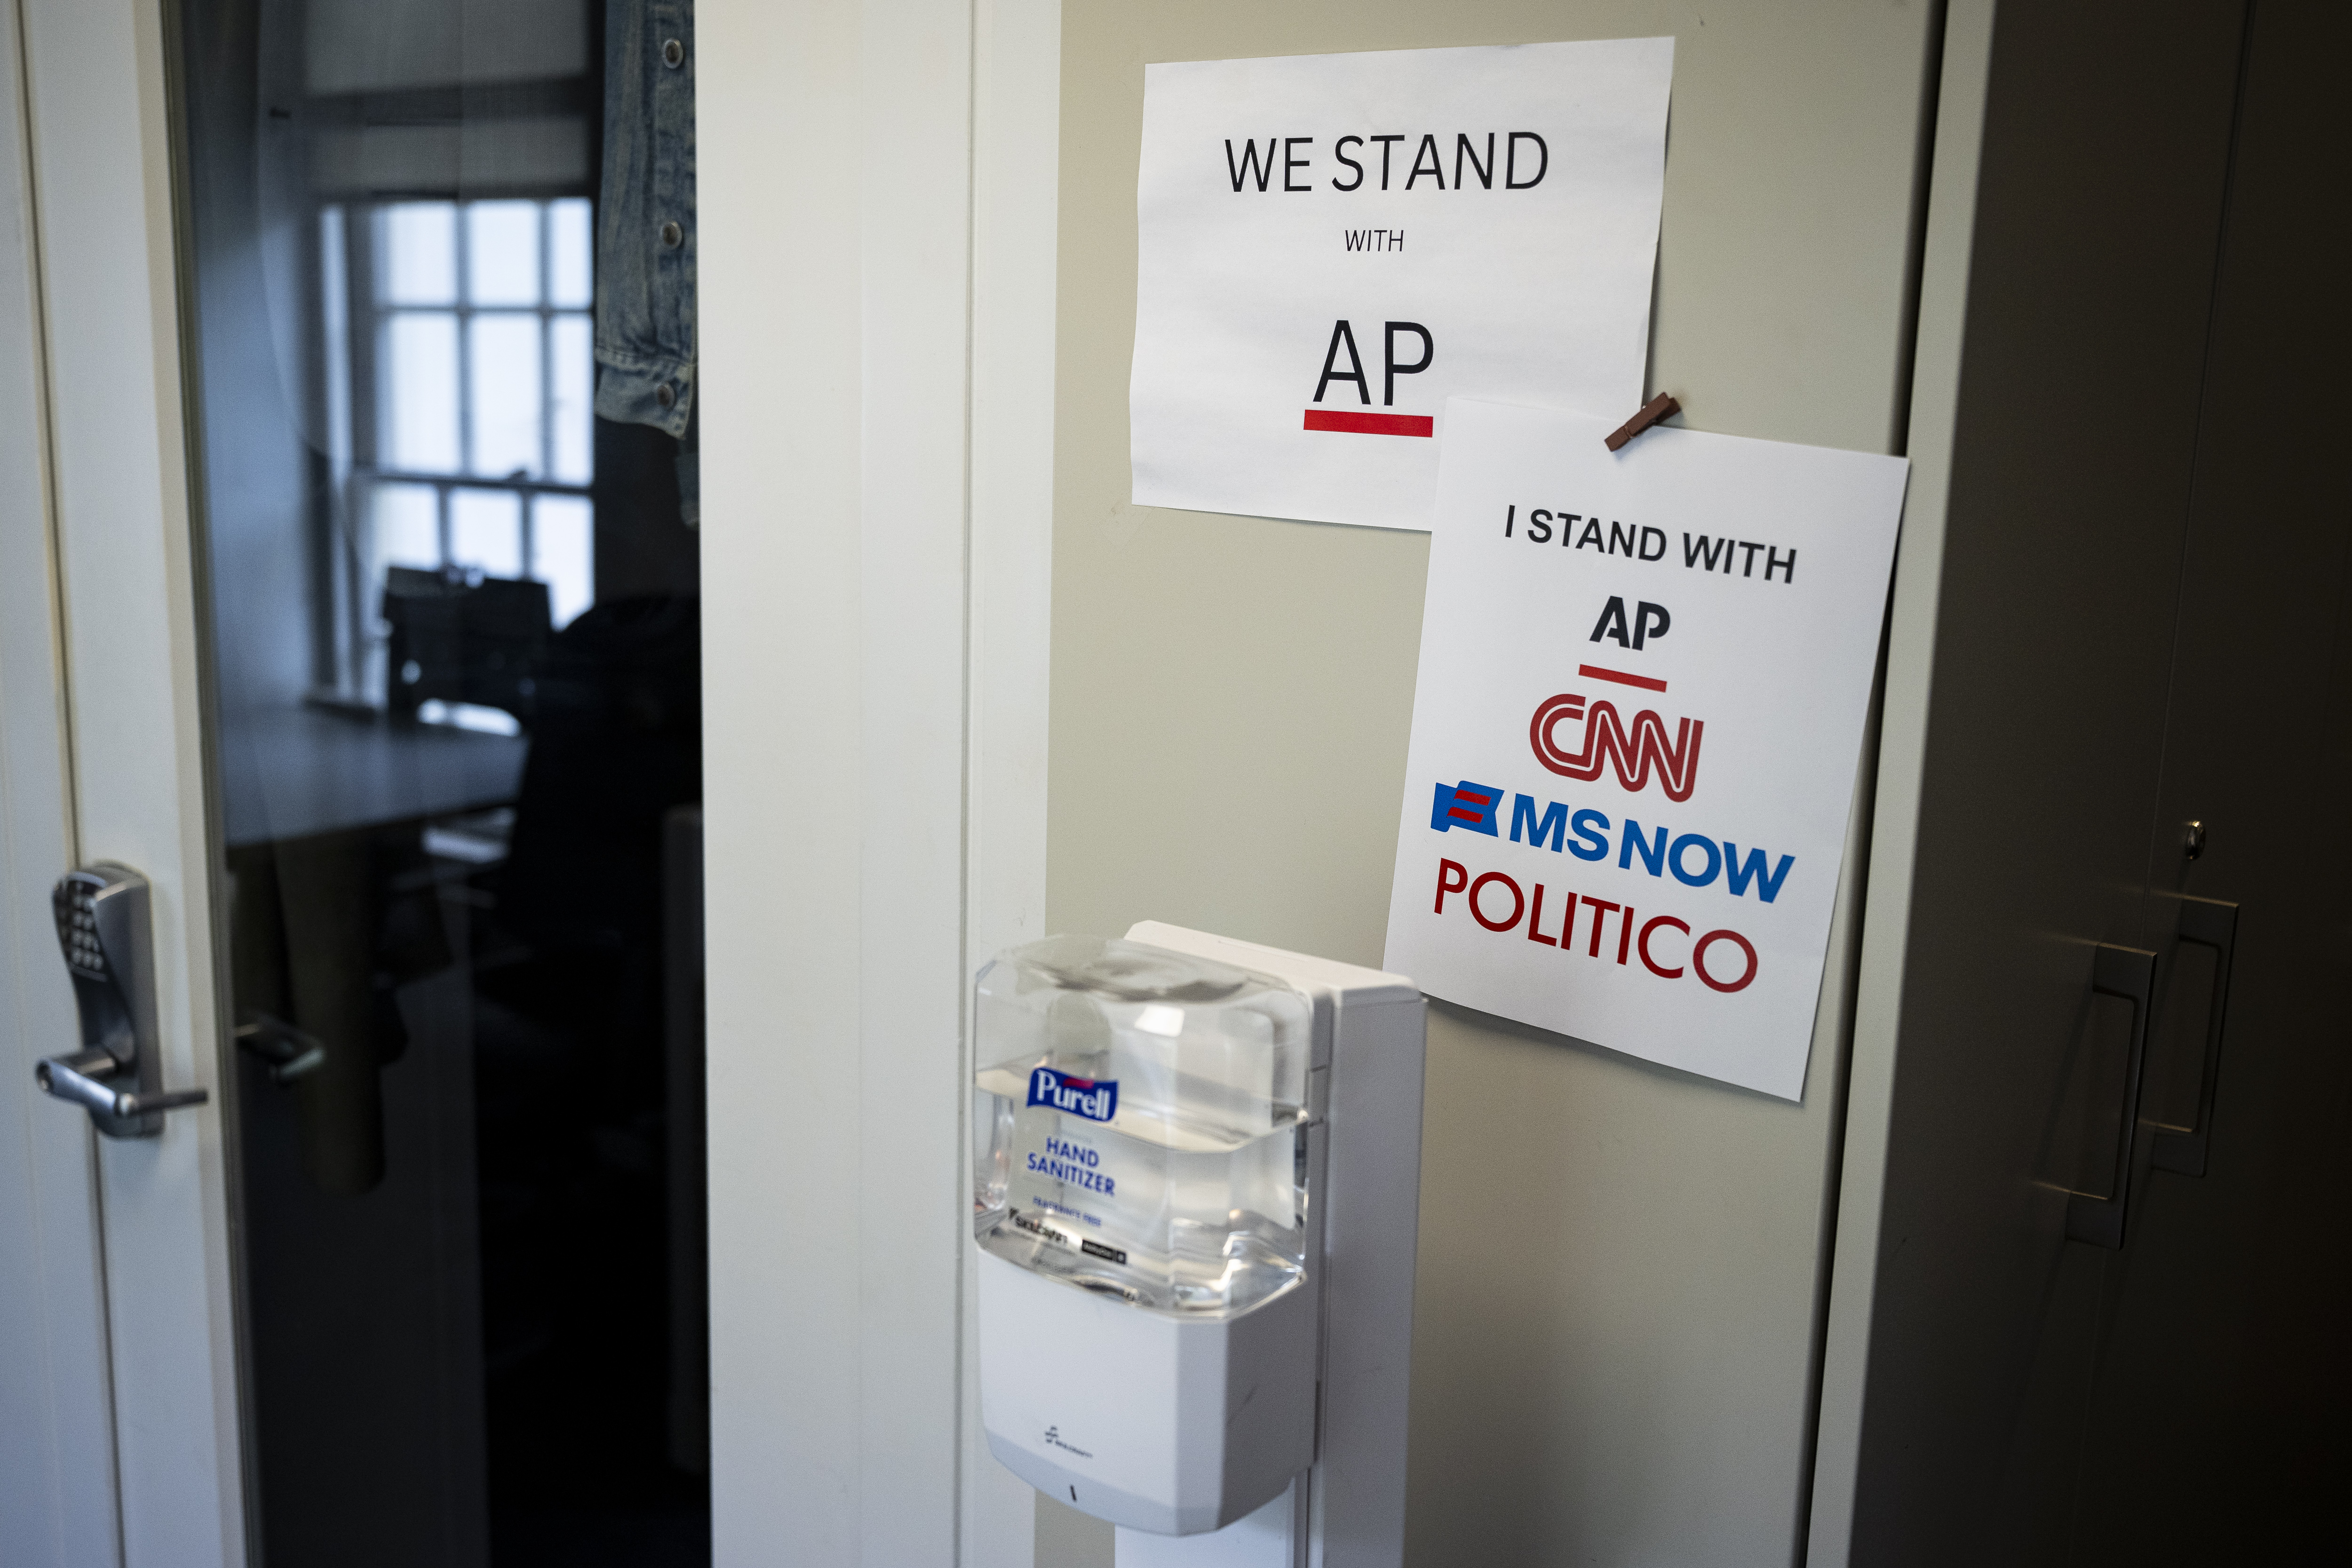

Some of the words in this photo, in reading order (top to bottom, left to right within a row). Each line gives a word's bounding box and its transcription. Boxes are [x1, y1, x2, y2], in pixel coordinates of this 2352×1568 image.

[1224, 137, 1313, 192] WE
[1332, 131, 1549, 192] STAND
[1345, 229, 1404, 252] WITH
[1312, 319, 1434, 406] AP
[1505, 505, 1515, 538] I
[1527, 509, 1667, 562] STAND
[1683, 533, 1797, 584] WITH
[1589, 596, 1670, 651] AP
[1530, 693, 1704, 802] CNN
[1510, 793, 1611, 862] MS
[1619, 819, 1796, 904] NOW
[1434, 858, 1758, 993] POLITICO
[1036, 1069, 1111, 1121] Purell
[1027, 1152, 1116, 1197] SANITIZER
[1046, 1136, 1100, 1169] HAND
